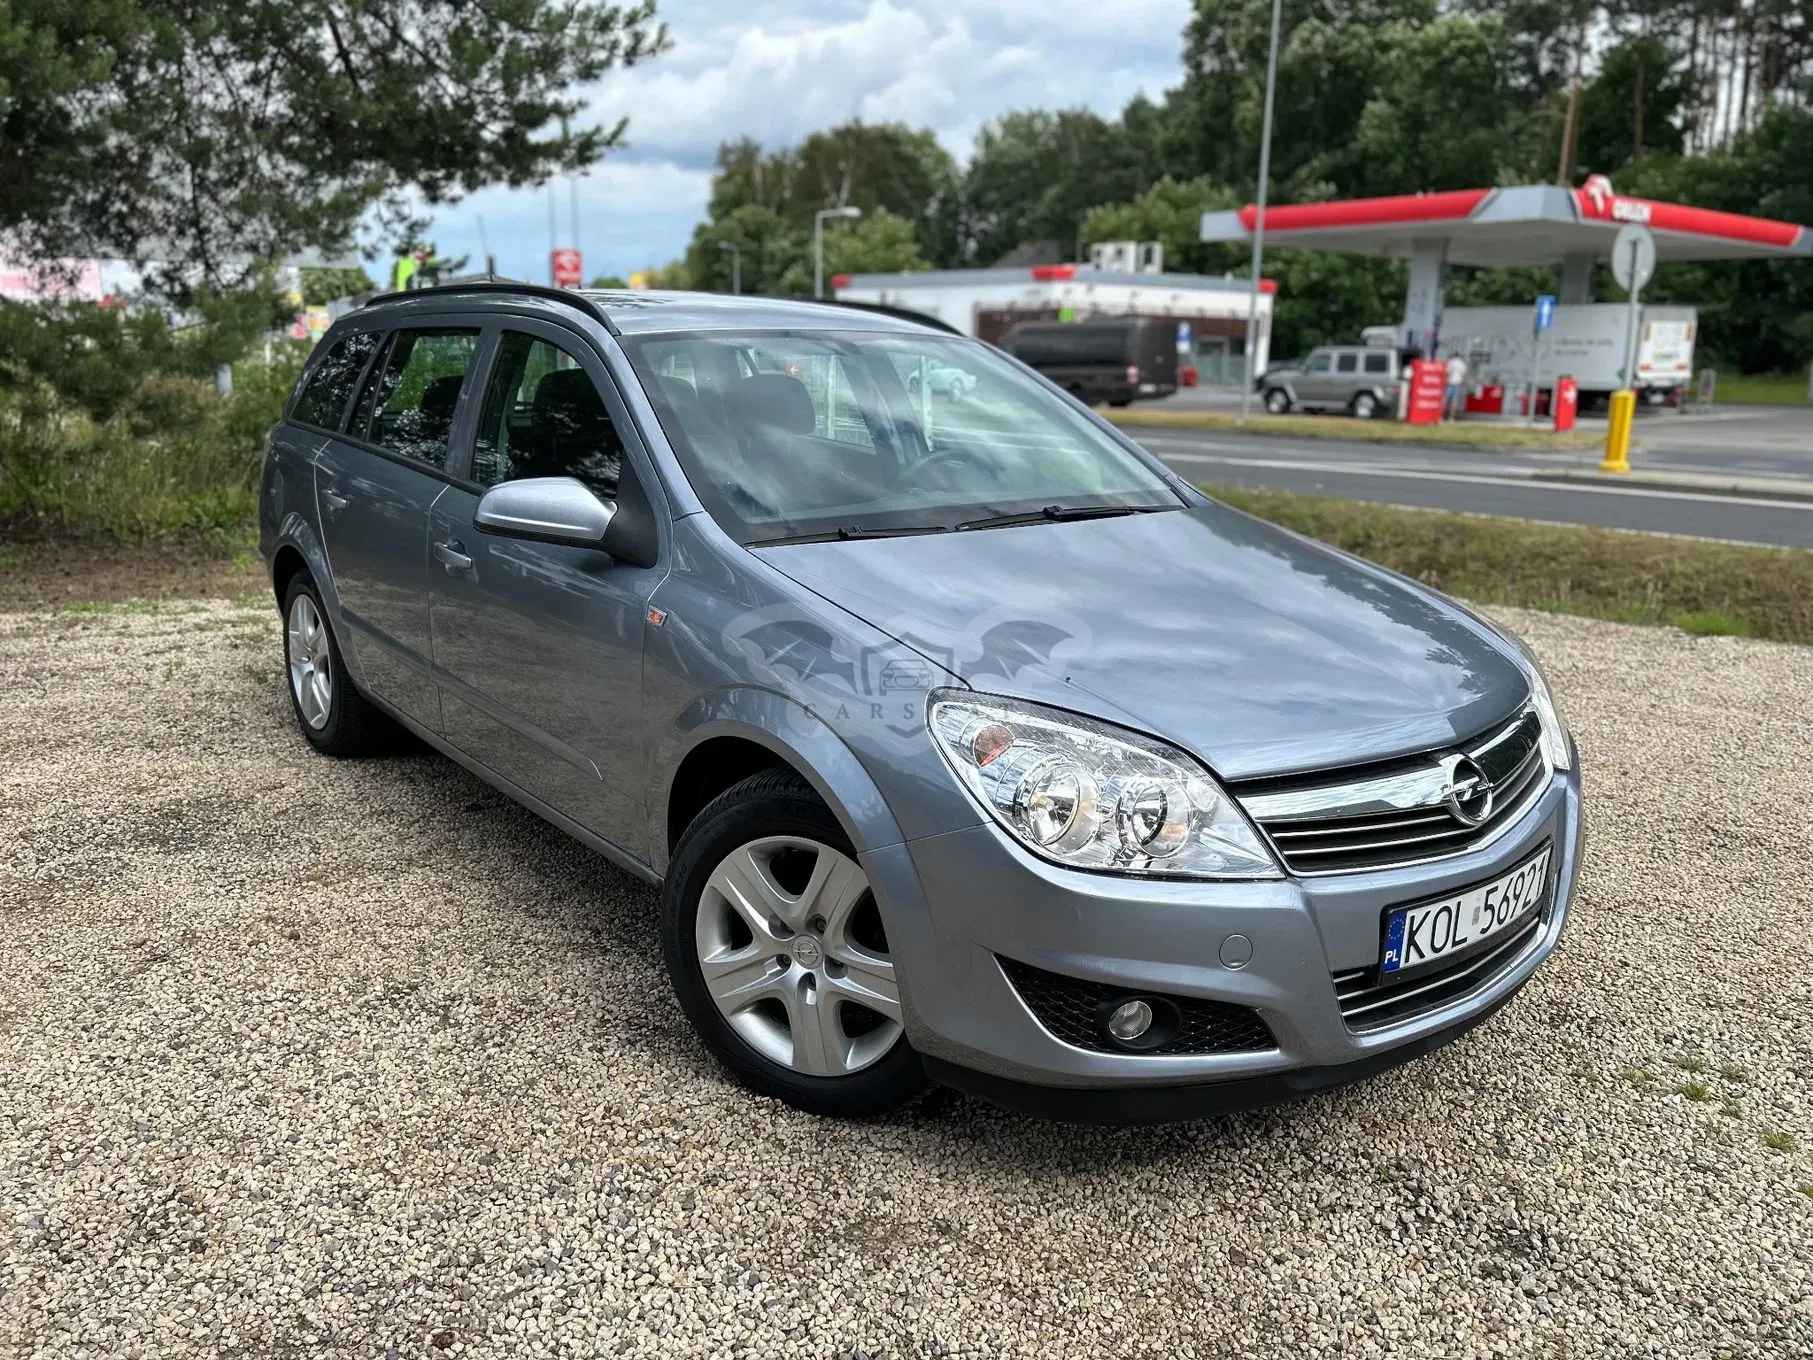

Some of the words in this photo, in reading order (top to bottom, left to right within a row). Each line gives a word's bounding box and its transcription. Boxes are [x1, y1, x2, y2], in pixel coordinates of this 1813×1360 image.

[1404, 900, 1468, 963] KOL
[1480, 854, 1547, 935] 56921
[1384, 949, 1399, 964] PL
